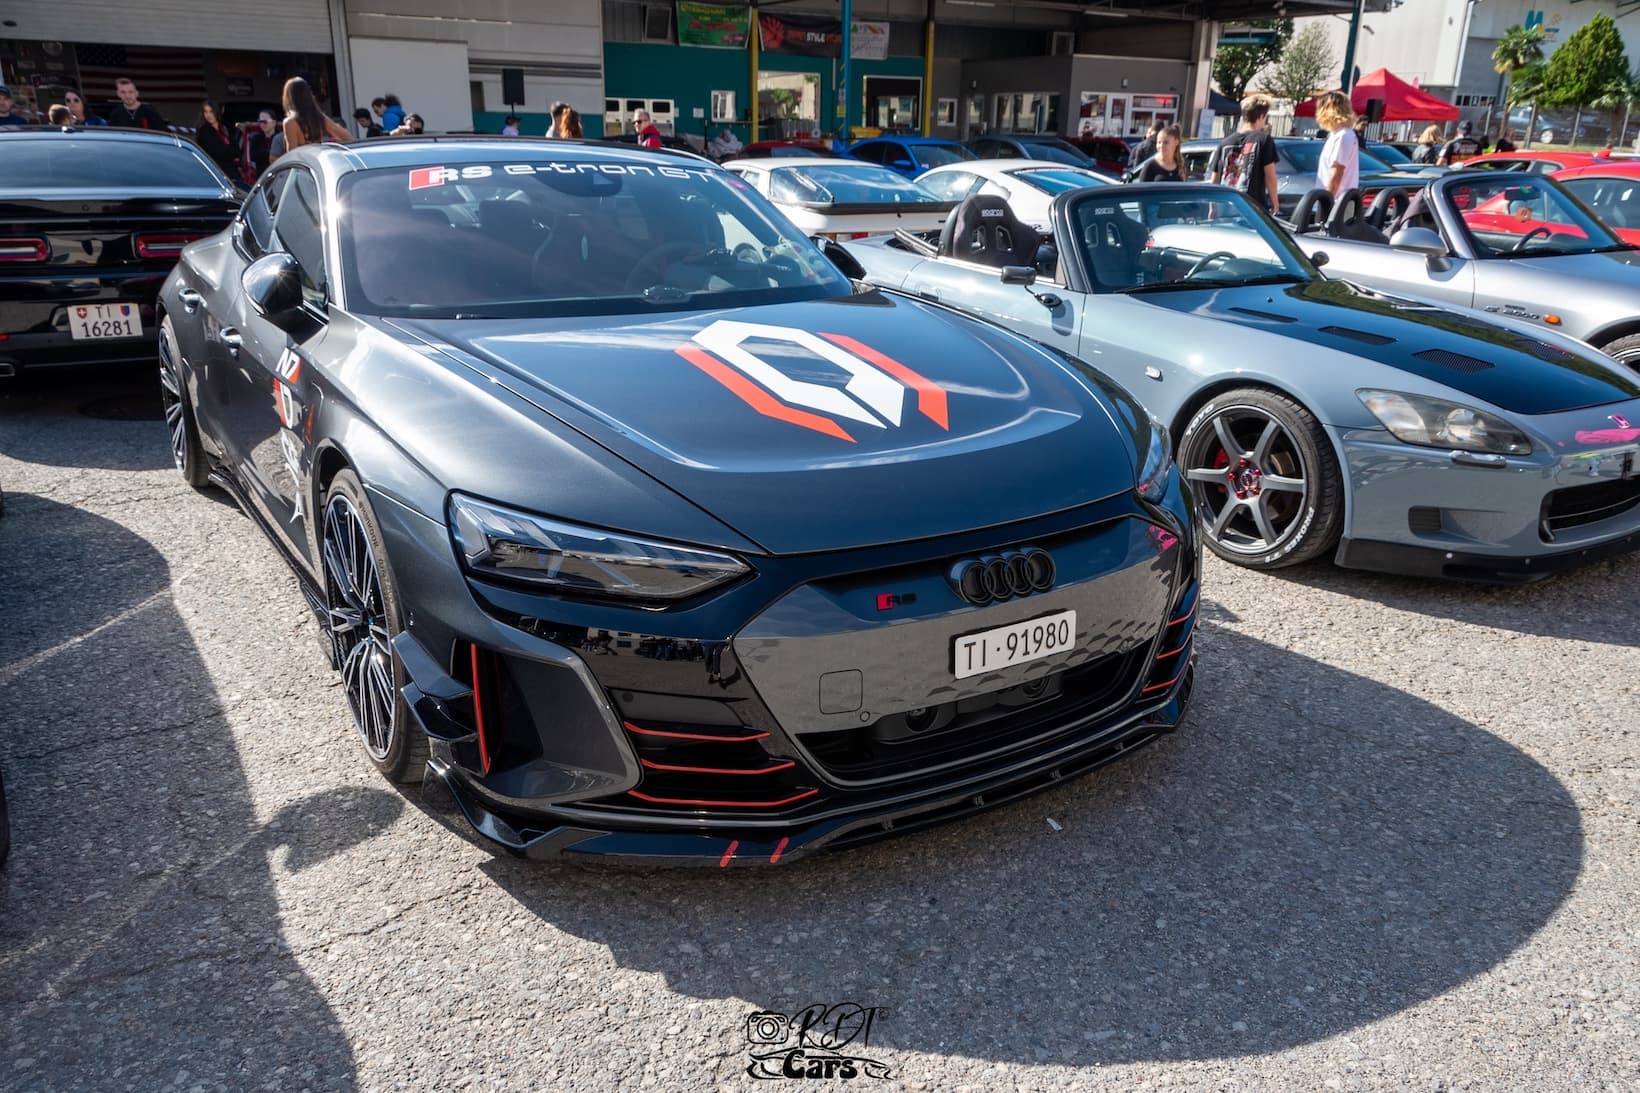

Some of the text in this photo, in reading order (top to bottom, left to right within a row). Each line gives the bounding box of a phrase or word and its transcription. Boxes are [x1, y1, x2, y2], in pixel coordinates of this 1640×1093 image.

[426, 162, 714, 186] RS e-tron GT
[95, 305, 111, 319] TI
[81, 320, 133, 338] 16281
[1185, 403, 1214, 436] TOYO
